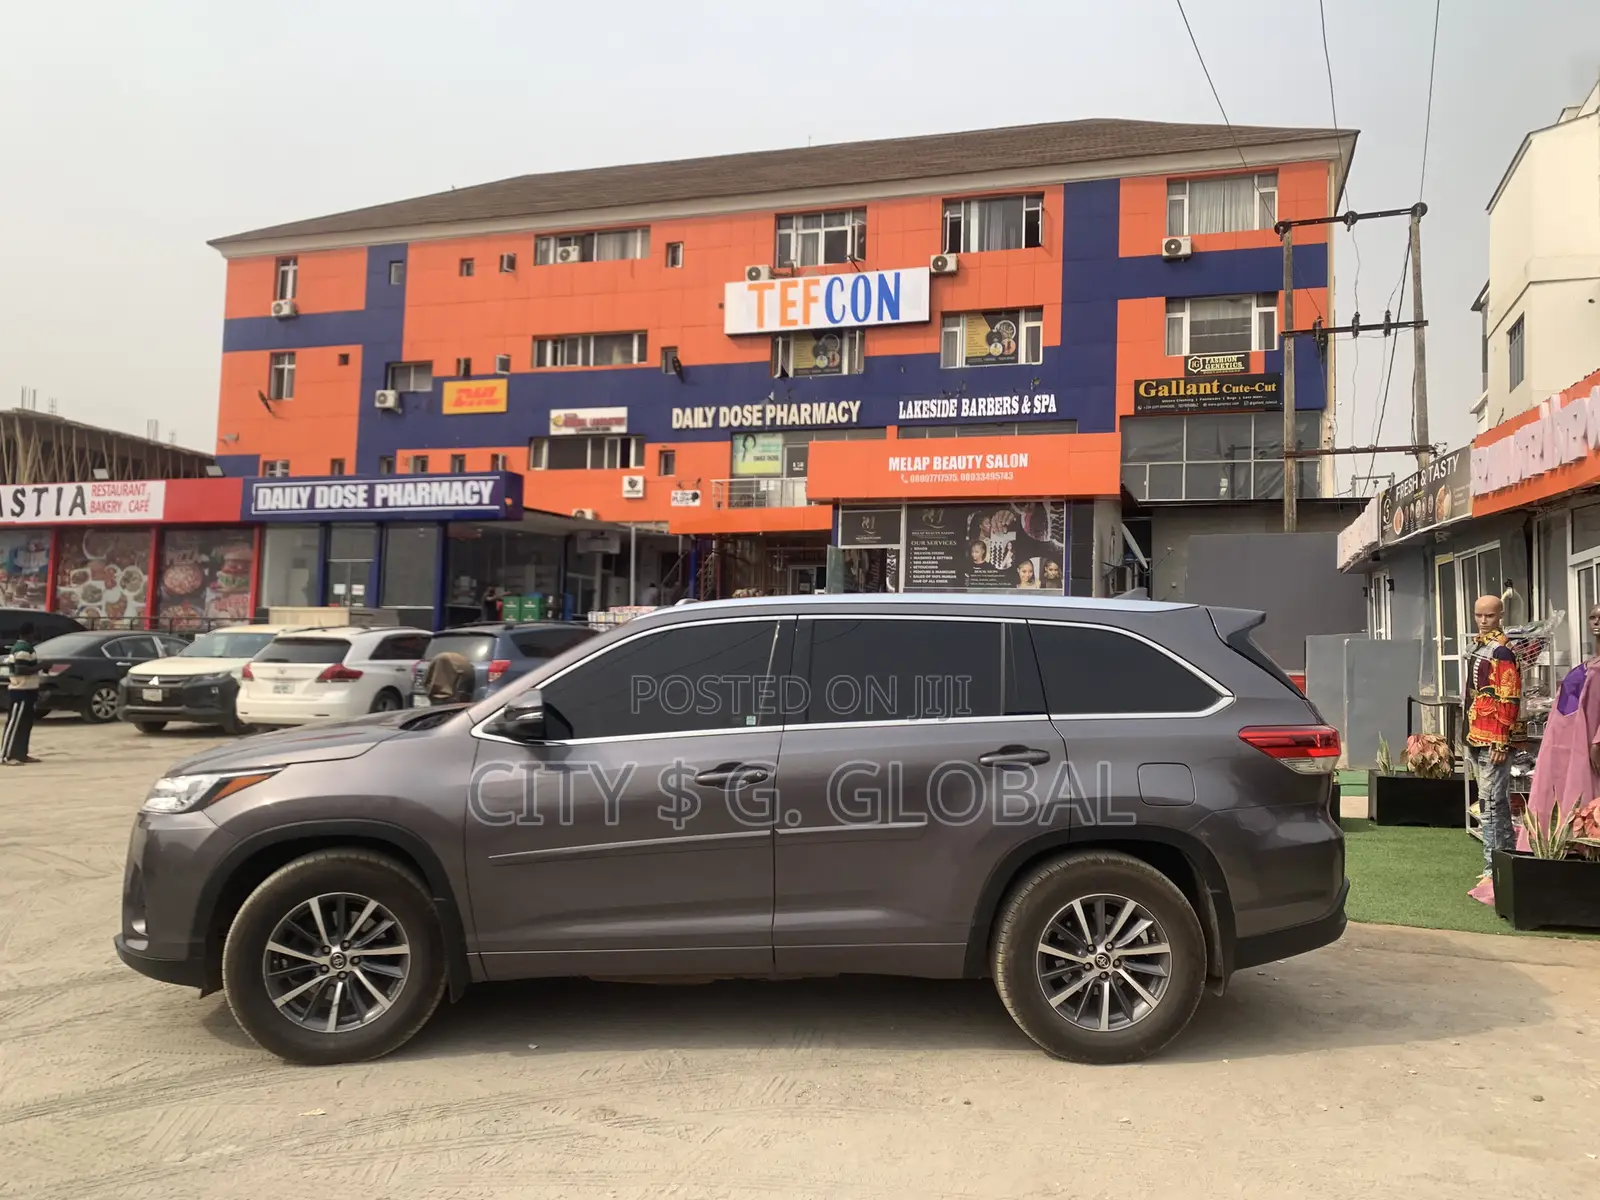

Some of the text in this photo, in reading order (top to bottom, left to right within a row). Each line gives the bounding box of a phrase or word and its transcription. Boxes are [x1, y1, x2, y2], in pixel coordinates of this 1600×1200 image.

[747, 271, 901, 329] TEFCON
[1205, 356, 1238, 364] FASHION
[1205, 361, 1243, 370] GENETICS
[1138, 378, 1277, 398] Gallant Cute-Cut
[672, 400, 861, 429] DAILY DOSE PHARMACY
[898, 393, 1057, 420] LAKESIDE BARBERS & SPA
[888, 452, 1029, 472] MELAP BEAUTY SALON
[1395, 453, 1460, 502] FRESH & TASTY
[91, 483, 147, 497] RESTAURANT
[257, 480, 494, 511] DAILY DOSE PHARMACY
[90, 497, 150, 513] BAKERY CAFÉ
